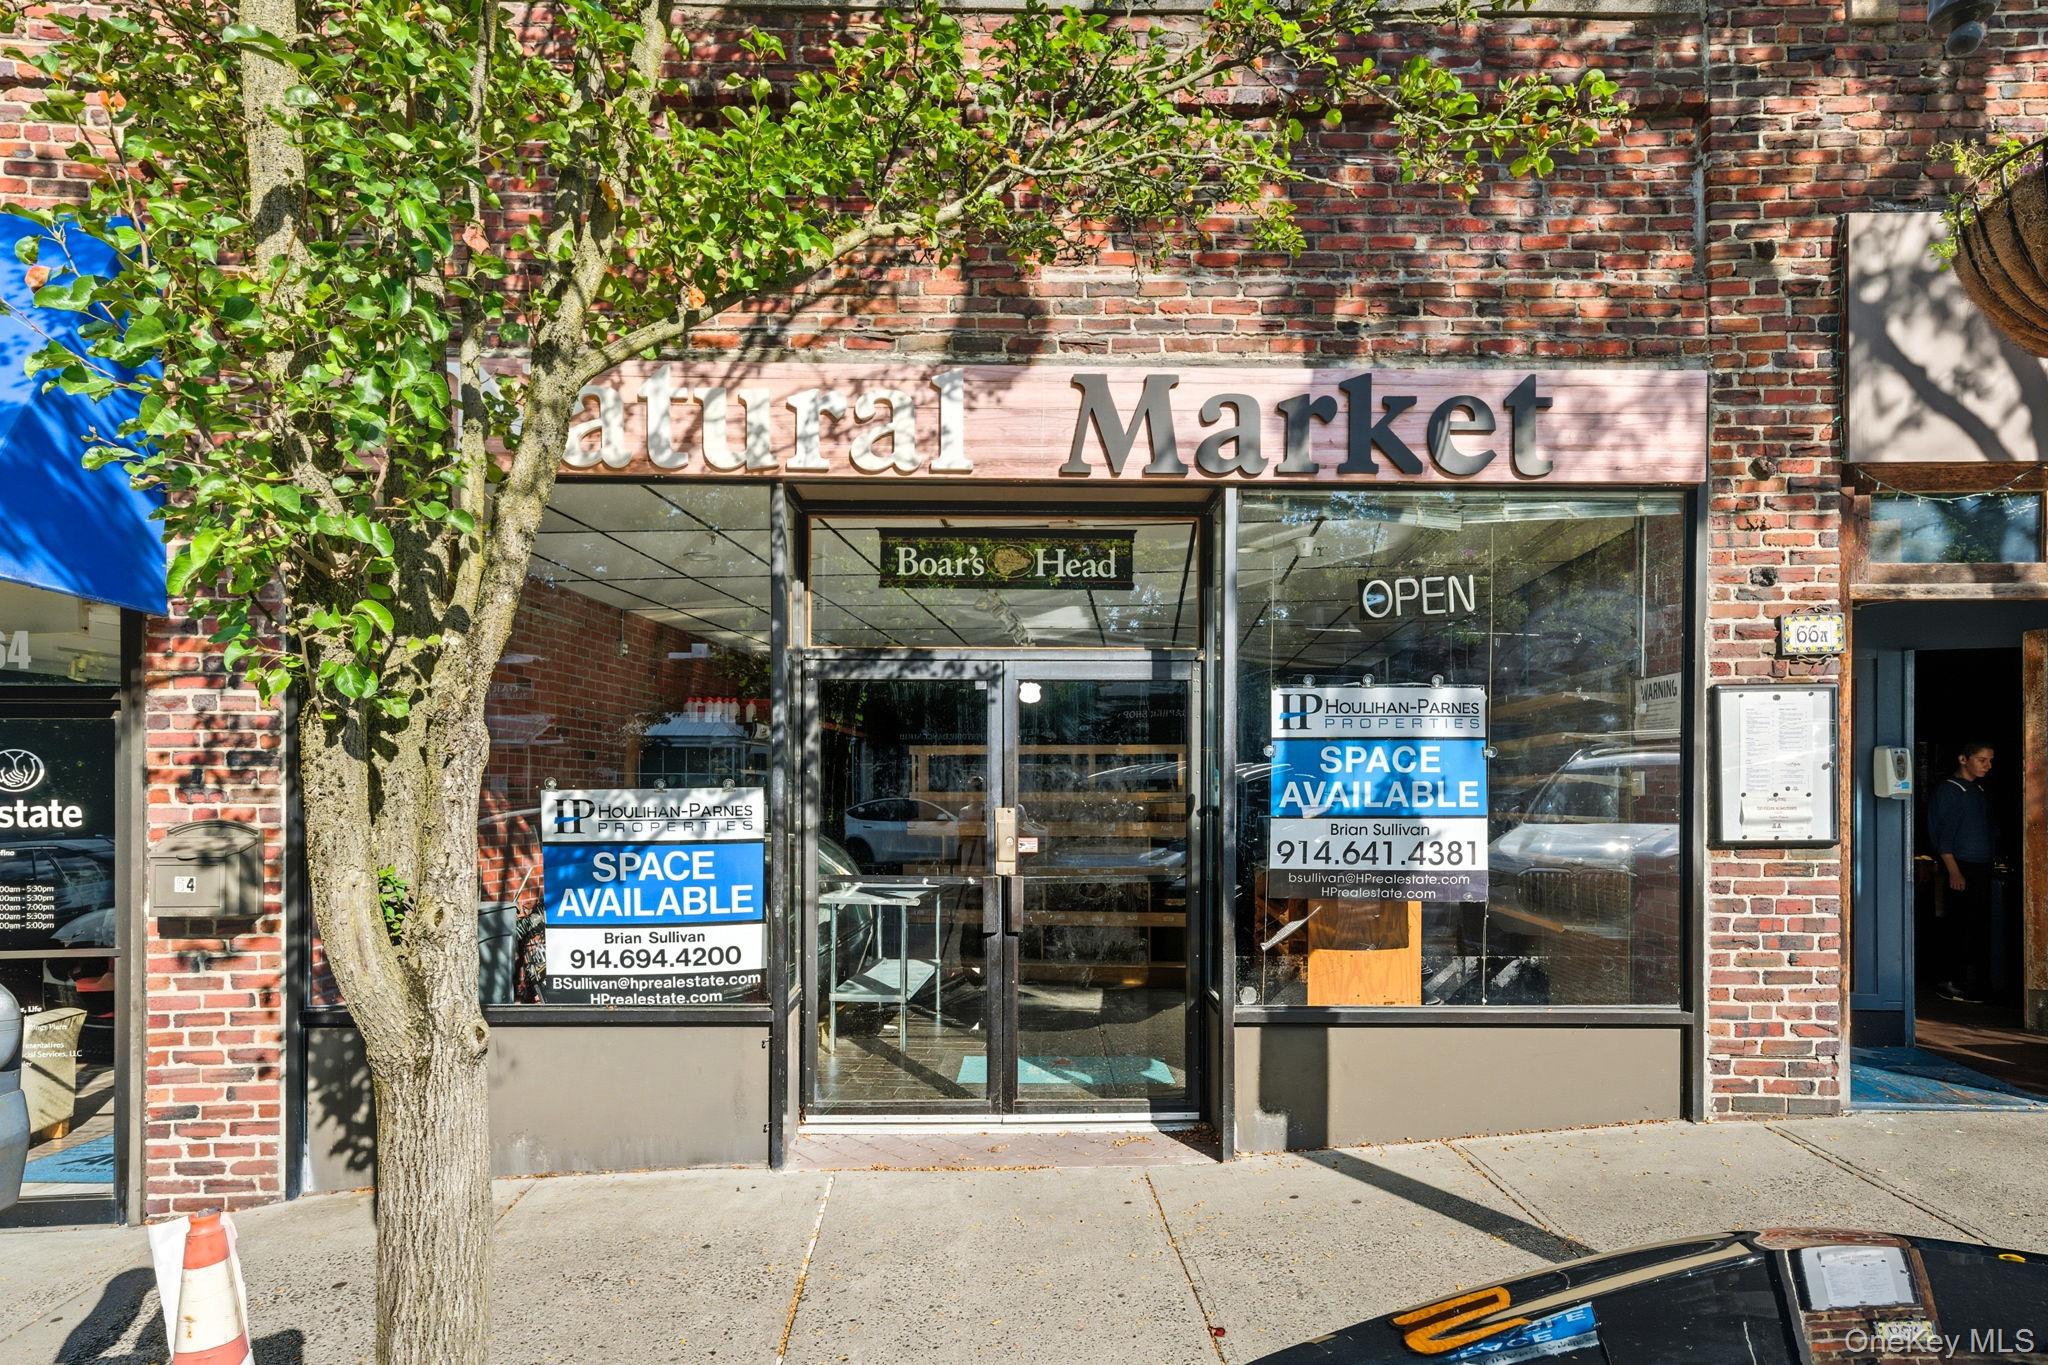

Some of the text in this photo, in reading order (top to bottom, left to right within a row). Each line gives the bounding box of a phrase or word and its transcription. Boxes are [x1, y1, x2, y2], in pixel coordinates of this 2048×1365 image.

[1059, 372, 1555, 479] Market
[895, 546, 1118, 579] Boar's Head
[1362, 575, 1475, 619] OPEN
[0, 630, 31, 669] 4
[1640, 680, 1678, 700] WARNING
[1279, 693, 1322, 730] HP
[1325, 698, 1480, 714] HOULIHAN-PARNES
[1324, 718, 1480, 729] PROPERTIES
[1320, 745, 1441, 773] SPACE
[1279, 780, 1480, 808] AVAILABLE
[553, 799, 595, 834] HP
[598, 802, 753, 819] HOULIHAN-PARNES
[598, 820, 753, 833] PROPERTIES
[1330, 823, 1430, 836] Brian Sullivan
[1276, 840, 1477, 866] 914.641.4381
[592, 850, 715, 882] SPACE
[1288, 873, 1470, 886] bsullivan@HPrealestate.com
[557, 884, 754, 917] AVAILABLE
[1321, 887, 1436, 900] HPrealestate.com
[604, 931, 706, 945] Brian Sullivan
[570, 945, 742, 969] 914.694.4200
[553, 972, 761, 991] BSullivan@hprealestate.com
[590, 991, 723, 1005] HPrealestate.com
[69, 1049, 83, 1057] LLC
